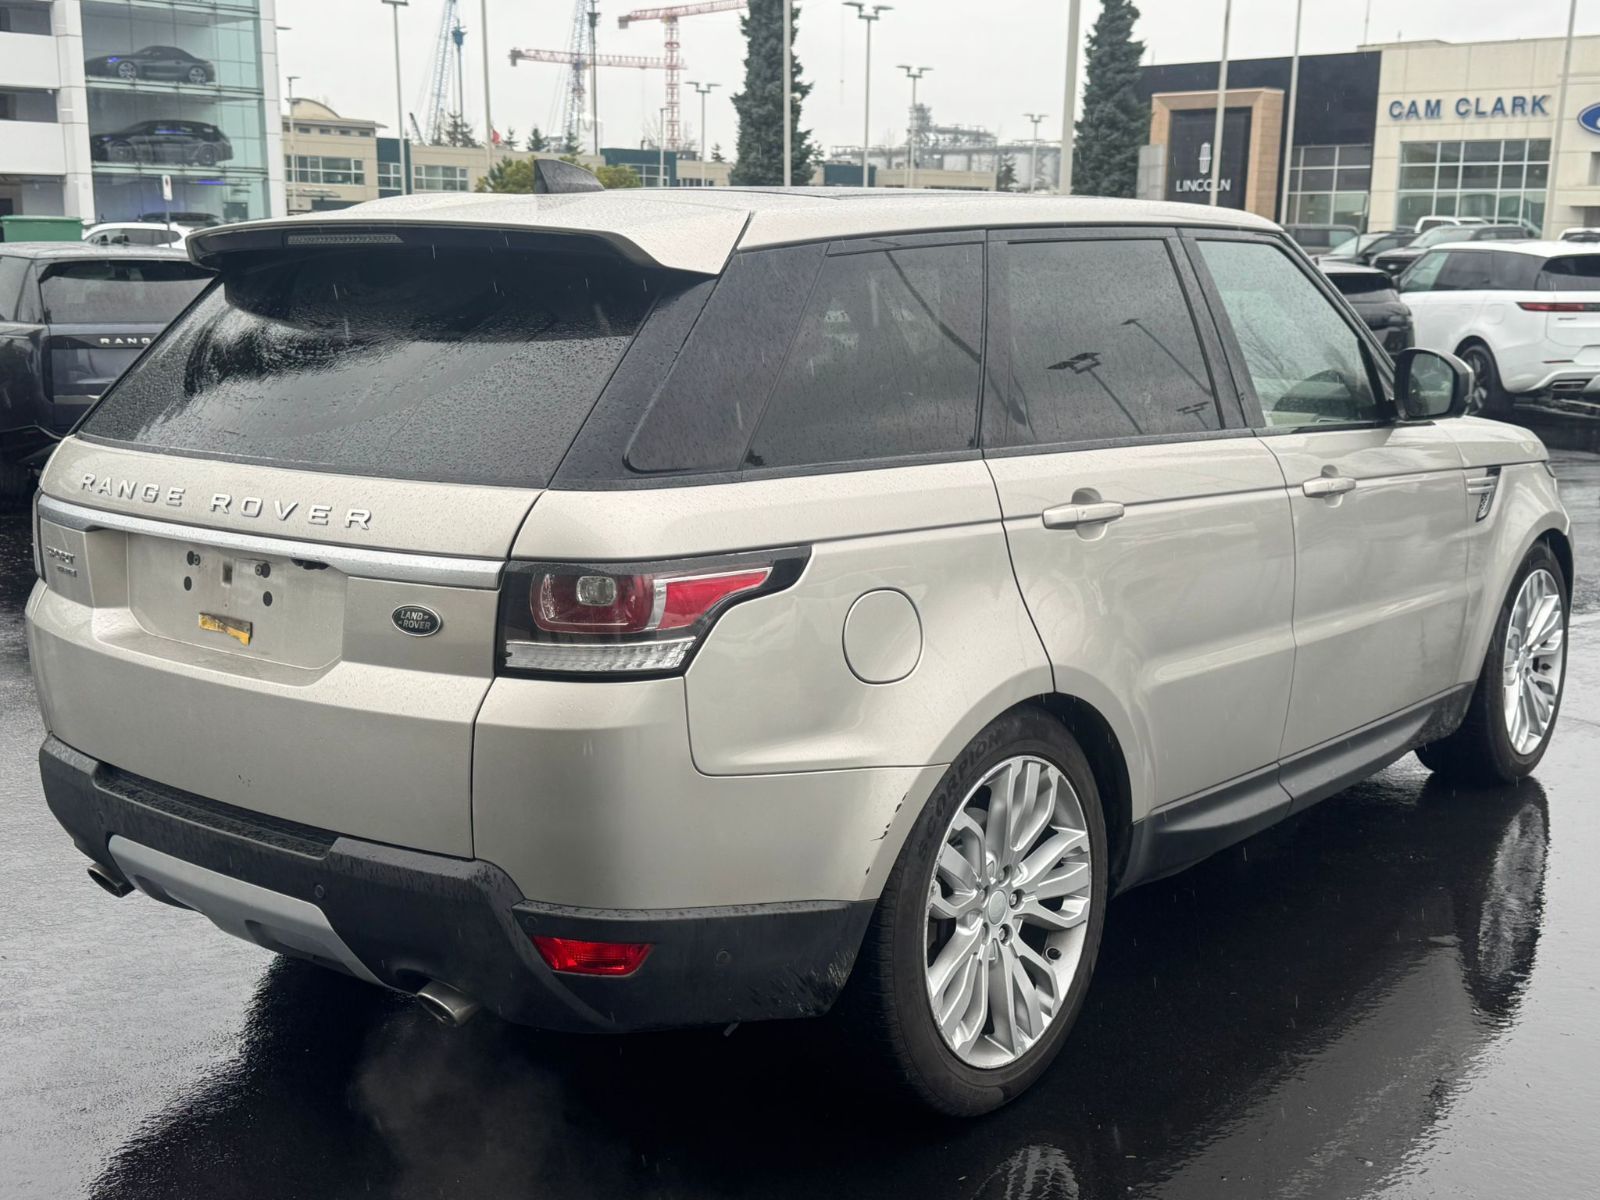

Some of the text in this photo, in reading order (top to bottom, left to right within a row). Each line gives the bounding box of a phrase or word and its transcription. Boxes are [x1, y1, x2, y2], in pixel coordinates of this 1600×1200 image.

[1389, 95, 1552, 119] CAM CLARK
[1175, 178, 1231, 192] LINCON
[81, 472, 372, 531] RANGE ROVER
[400, 610, 424, 621] LAND
[402, 619, 431, 631] ROVER
[917, 729, 1005, 862] SCORPION
